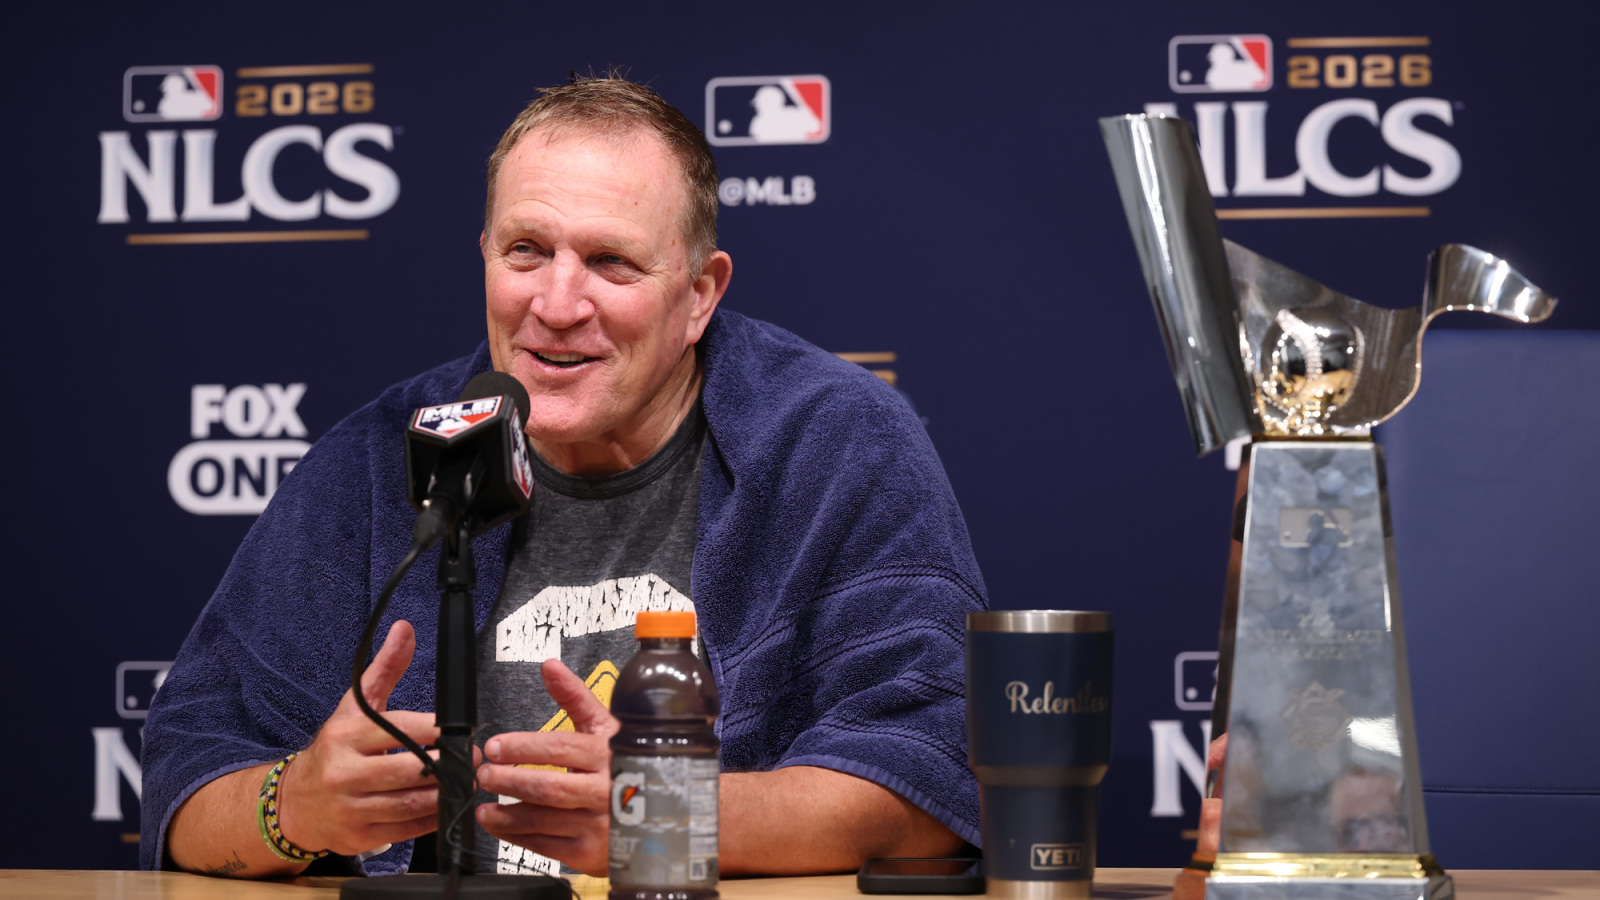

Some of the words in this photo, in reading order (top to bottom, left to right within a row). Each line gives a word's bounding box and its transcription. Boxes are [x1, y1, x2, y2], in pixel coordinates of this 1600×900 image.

[1287, 54, 1432, 88] 2026
[235, 81, 375, 117] 2026
[97, 122, 400, 224] NLCS
[718, 175, 816, 206] @MLB
[191, 382, 308, 439] FOX
[611, 771, 646, 826] G
[1035, 848, 1080, 865] YETI
